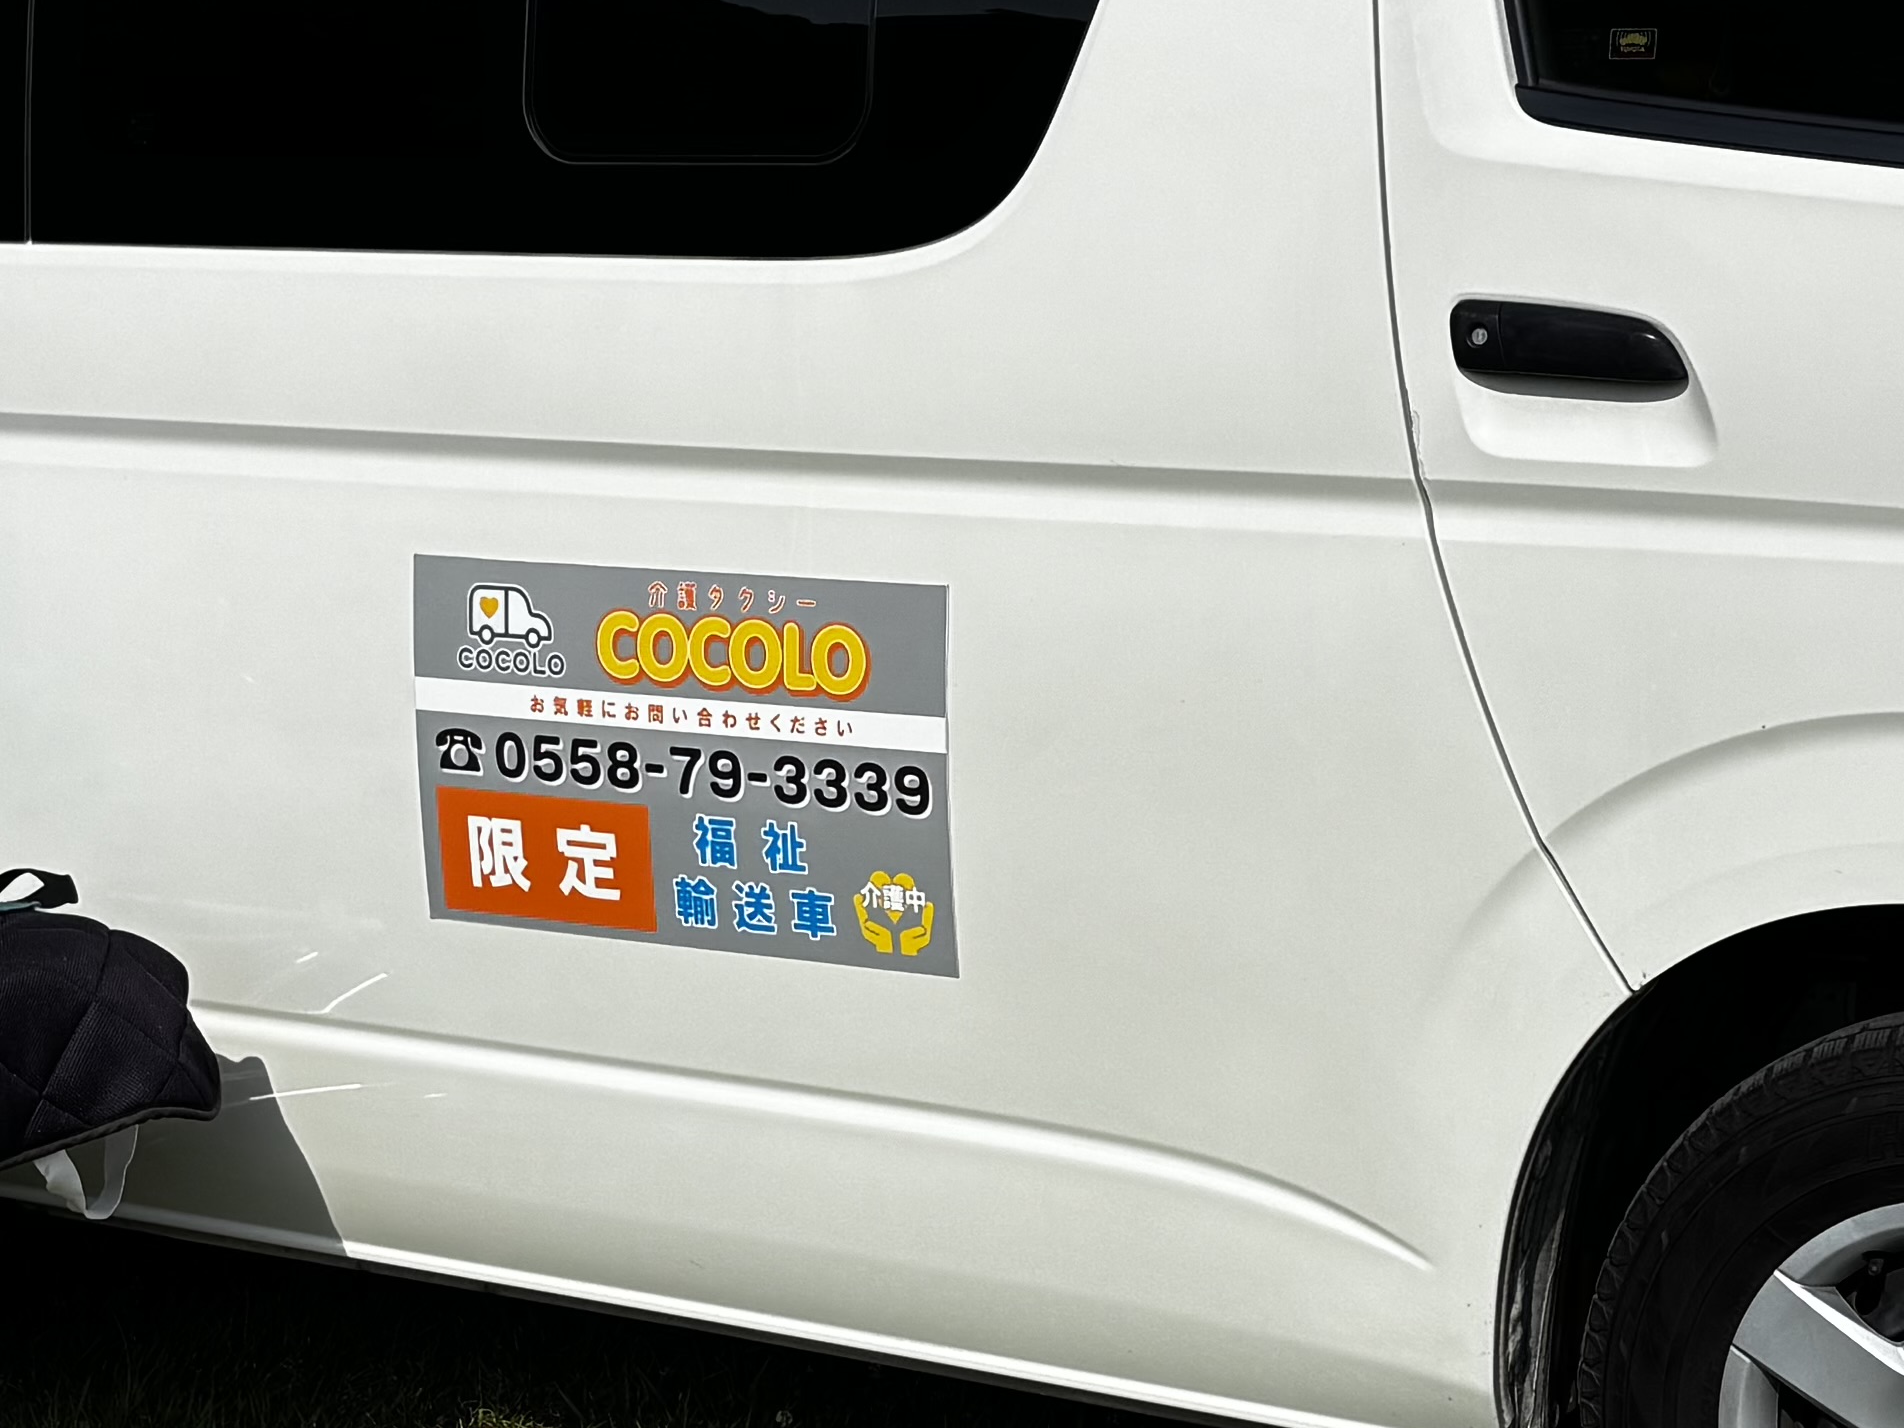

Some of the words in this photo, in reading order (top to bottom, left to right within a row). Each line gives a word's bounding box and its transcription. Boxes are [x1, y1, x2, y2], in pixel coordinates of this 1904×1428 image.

[647, 580, 817, 615] 介護タクシー
[456, 644, 567, 678] COCOLO
[595, 609, 872, 703] COCOLO
[529, 693, 854, 738] お気軽にお問い合わせください
[495, 730, 933, 819] 0558-79-3339
[465, 813, 623, 902] 限定
[693, 812, 809, 876] 福祉
[673, 874, 838, 941] 輸送車
[859, 880, 926, 914] 介護中
